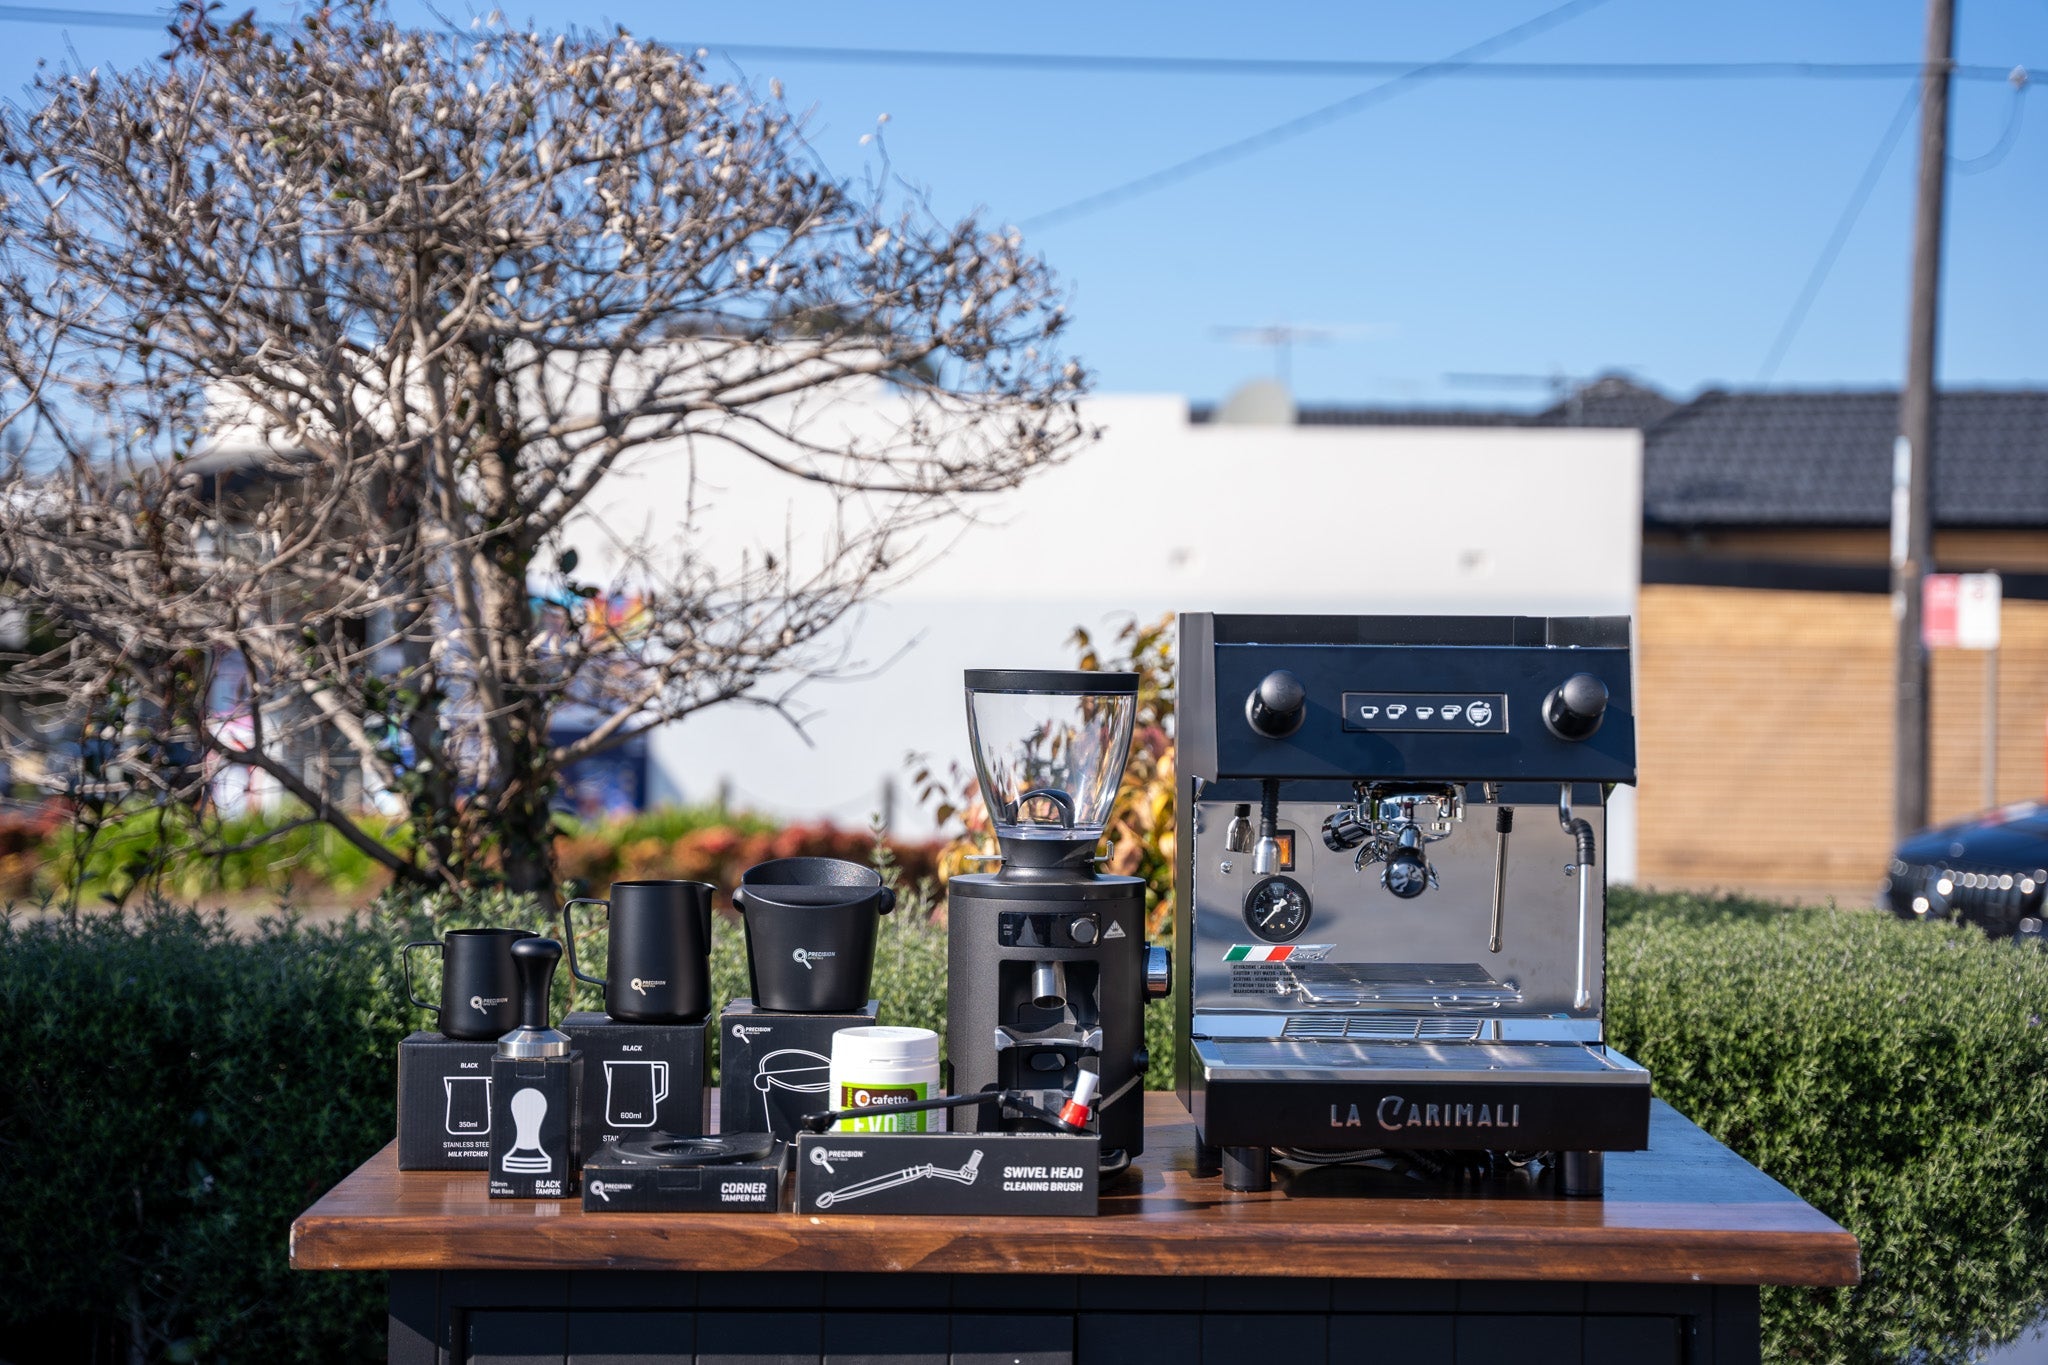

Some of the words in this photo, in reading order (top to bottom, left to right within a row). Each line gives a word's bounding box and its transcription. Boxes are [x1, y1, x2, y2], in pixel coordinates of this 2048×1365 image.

[872, 1095, 908, 1104] cafetto
[1331, 1104, 1362, 1127] LA
[1377, 1095, 1520, 1130] CARIMALI
[1004, 1166, 1048, 1178] SWIVEL
[1050, 1167, 1083, 1178] HEAD
[720, 1183, 767, 1193] CORNER
[1003, 1182, 1048, 1191] CLEANING
[1050, 1182, 1083, 1191] BRUSH
